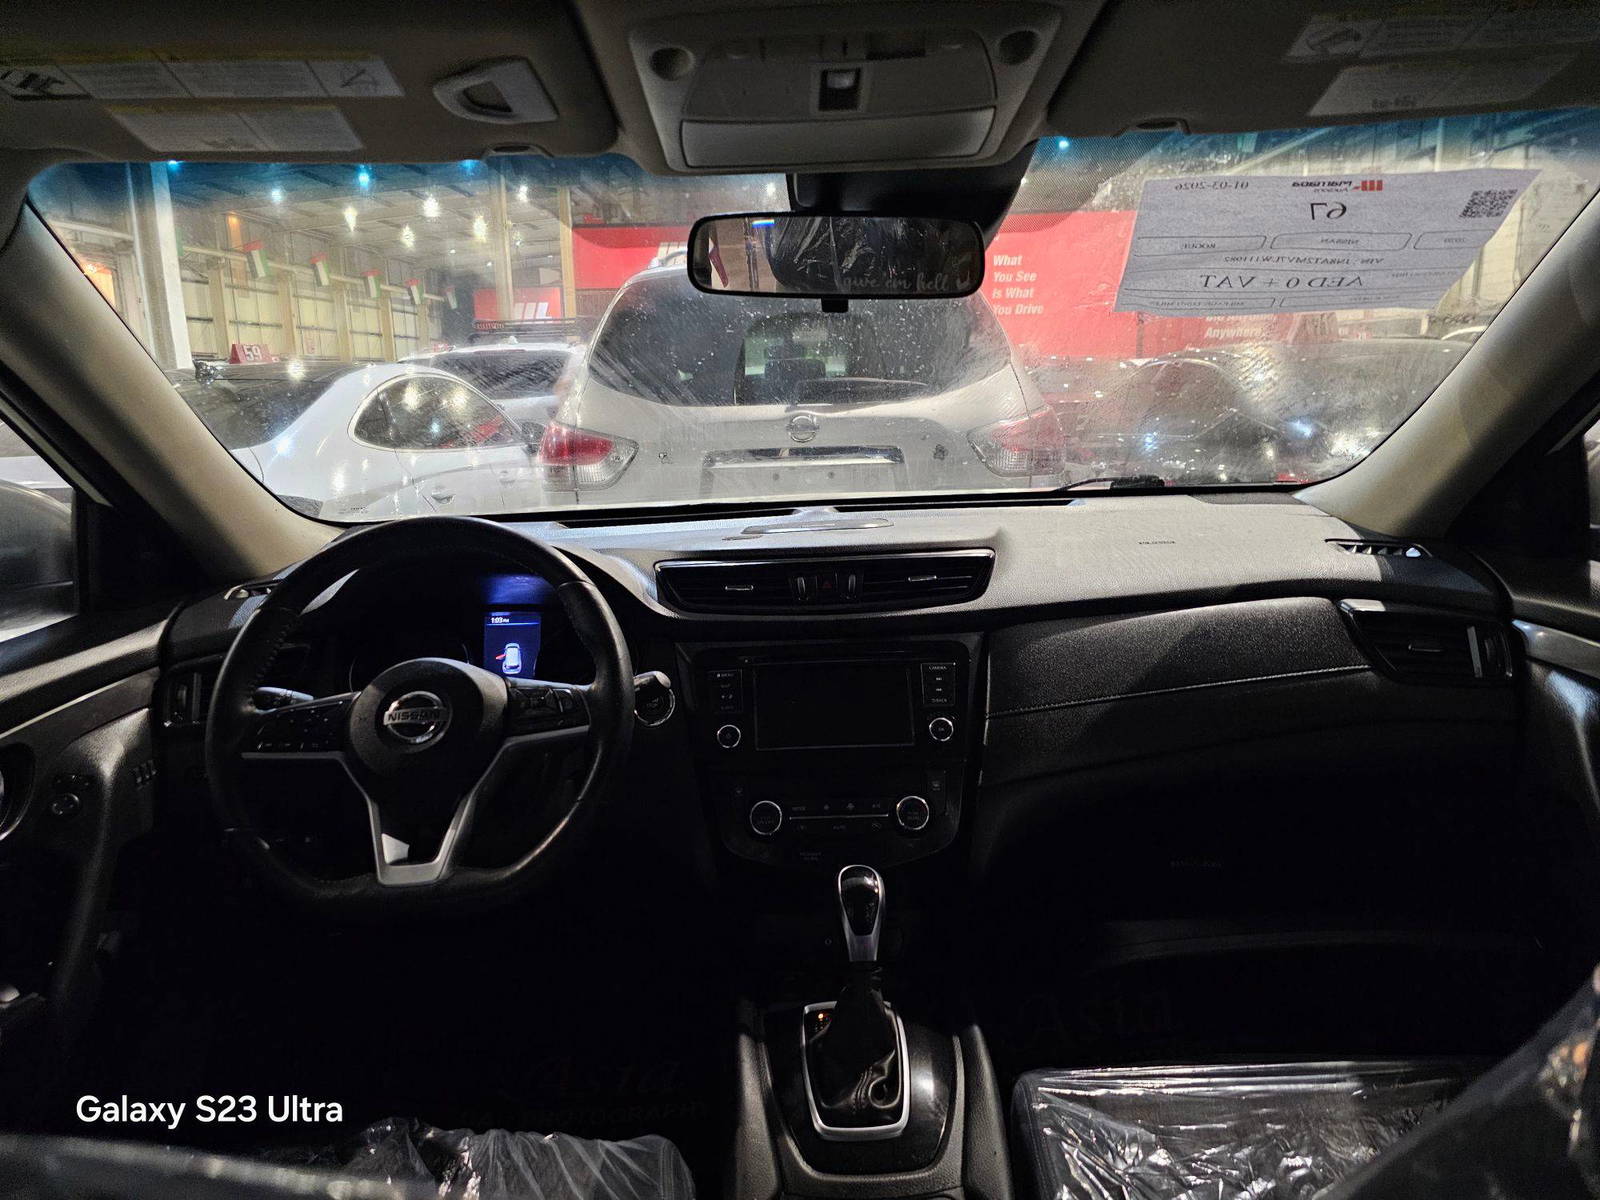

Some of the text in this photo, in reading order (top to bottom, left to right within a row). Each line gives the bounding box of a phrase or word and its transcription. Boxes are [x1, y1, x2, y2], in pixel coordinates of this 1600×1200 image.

[993, 255, 1023, 266] What
[994, 271, 1038, 283] You See
[1005, 288, 1034, 299] What
[1014, 304, 1044, 315] Drive
[242, 344, 263, 361] 59
